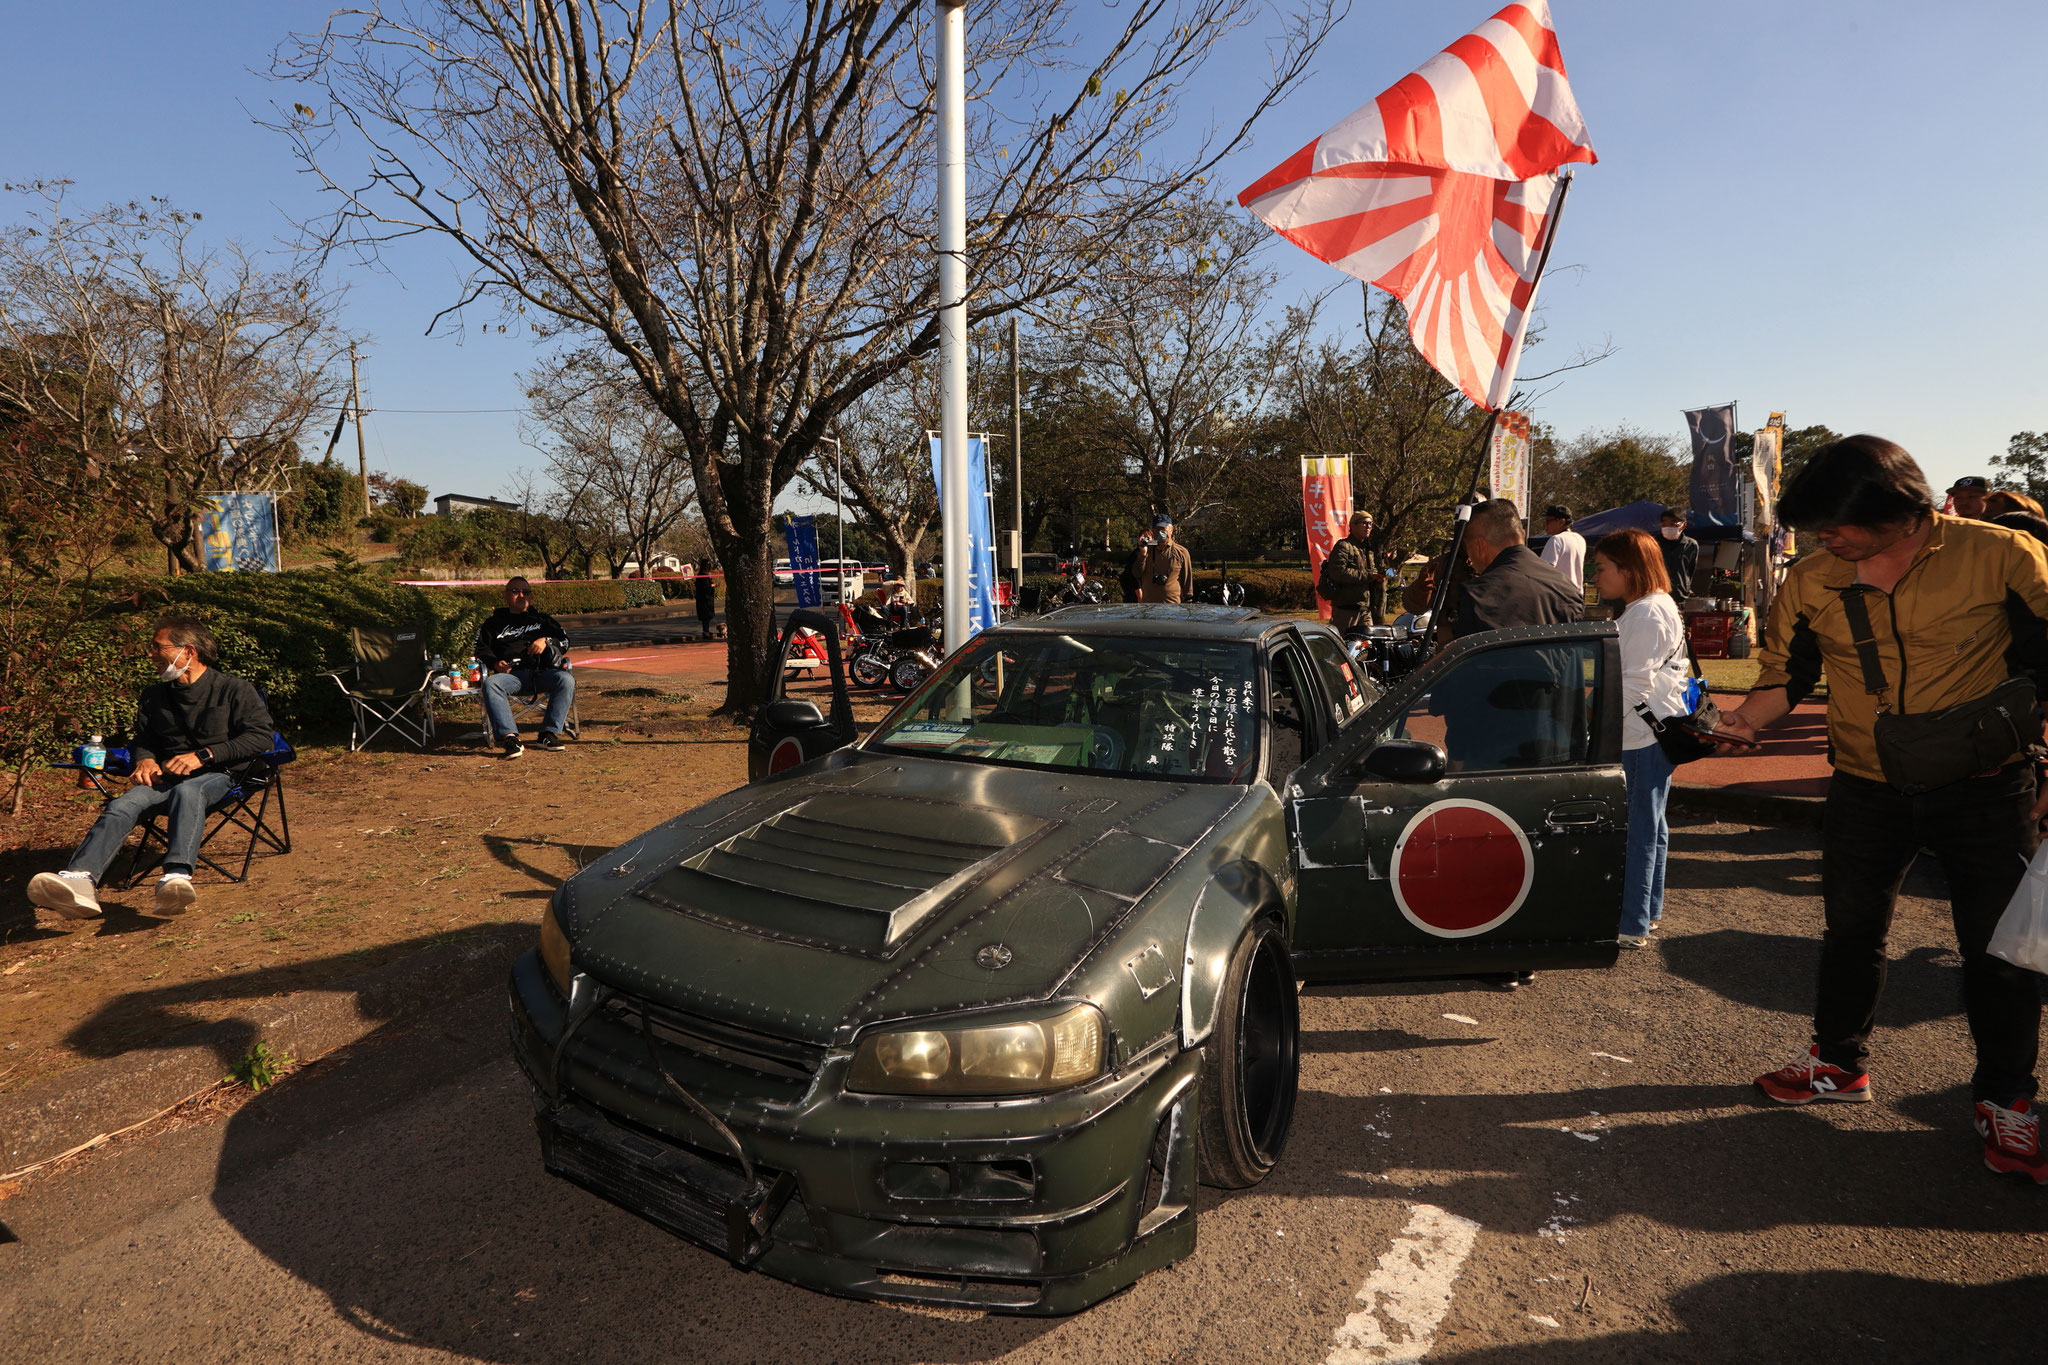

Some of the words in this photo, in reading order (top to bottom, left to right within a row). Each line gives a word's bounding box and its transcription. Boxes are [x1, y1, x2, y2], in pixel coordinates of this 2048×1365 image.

[1161, 723, 1176, 751] 特攻隊
[1812, 1075, 1838, 1094] N
